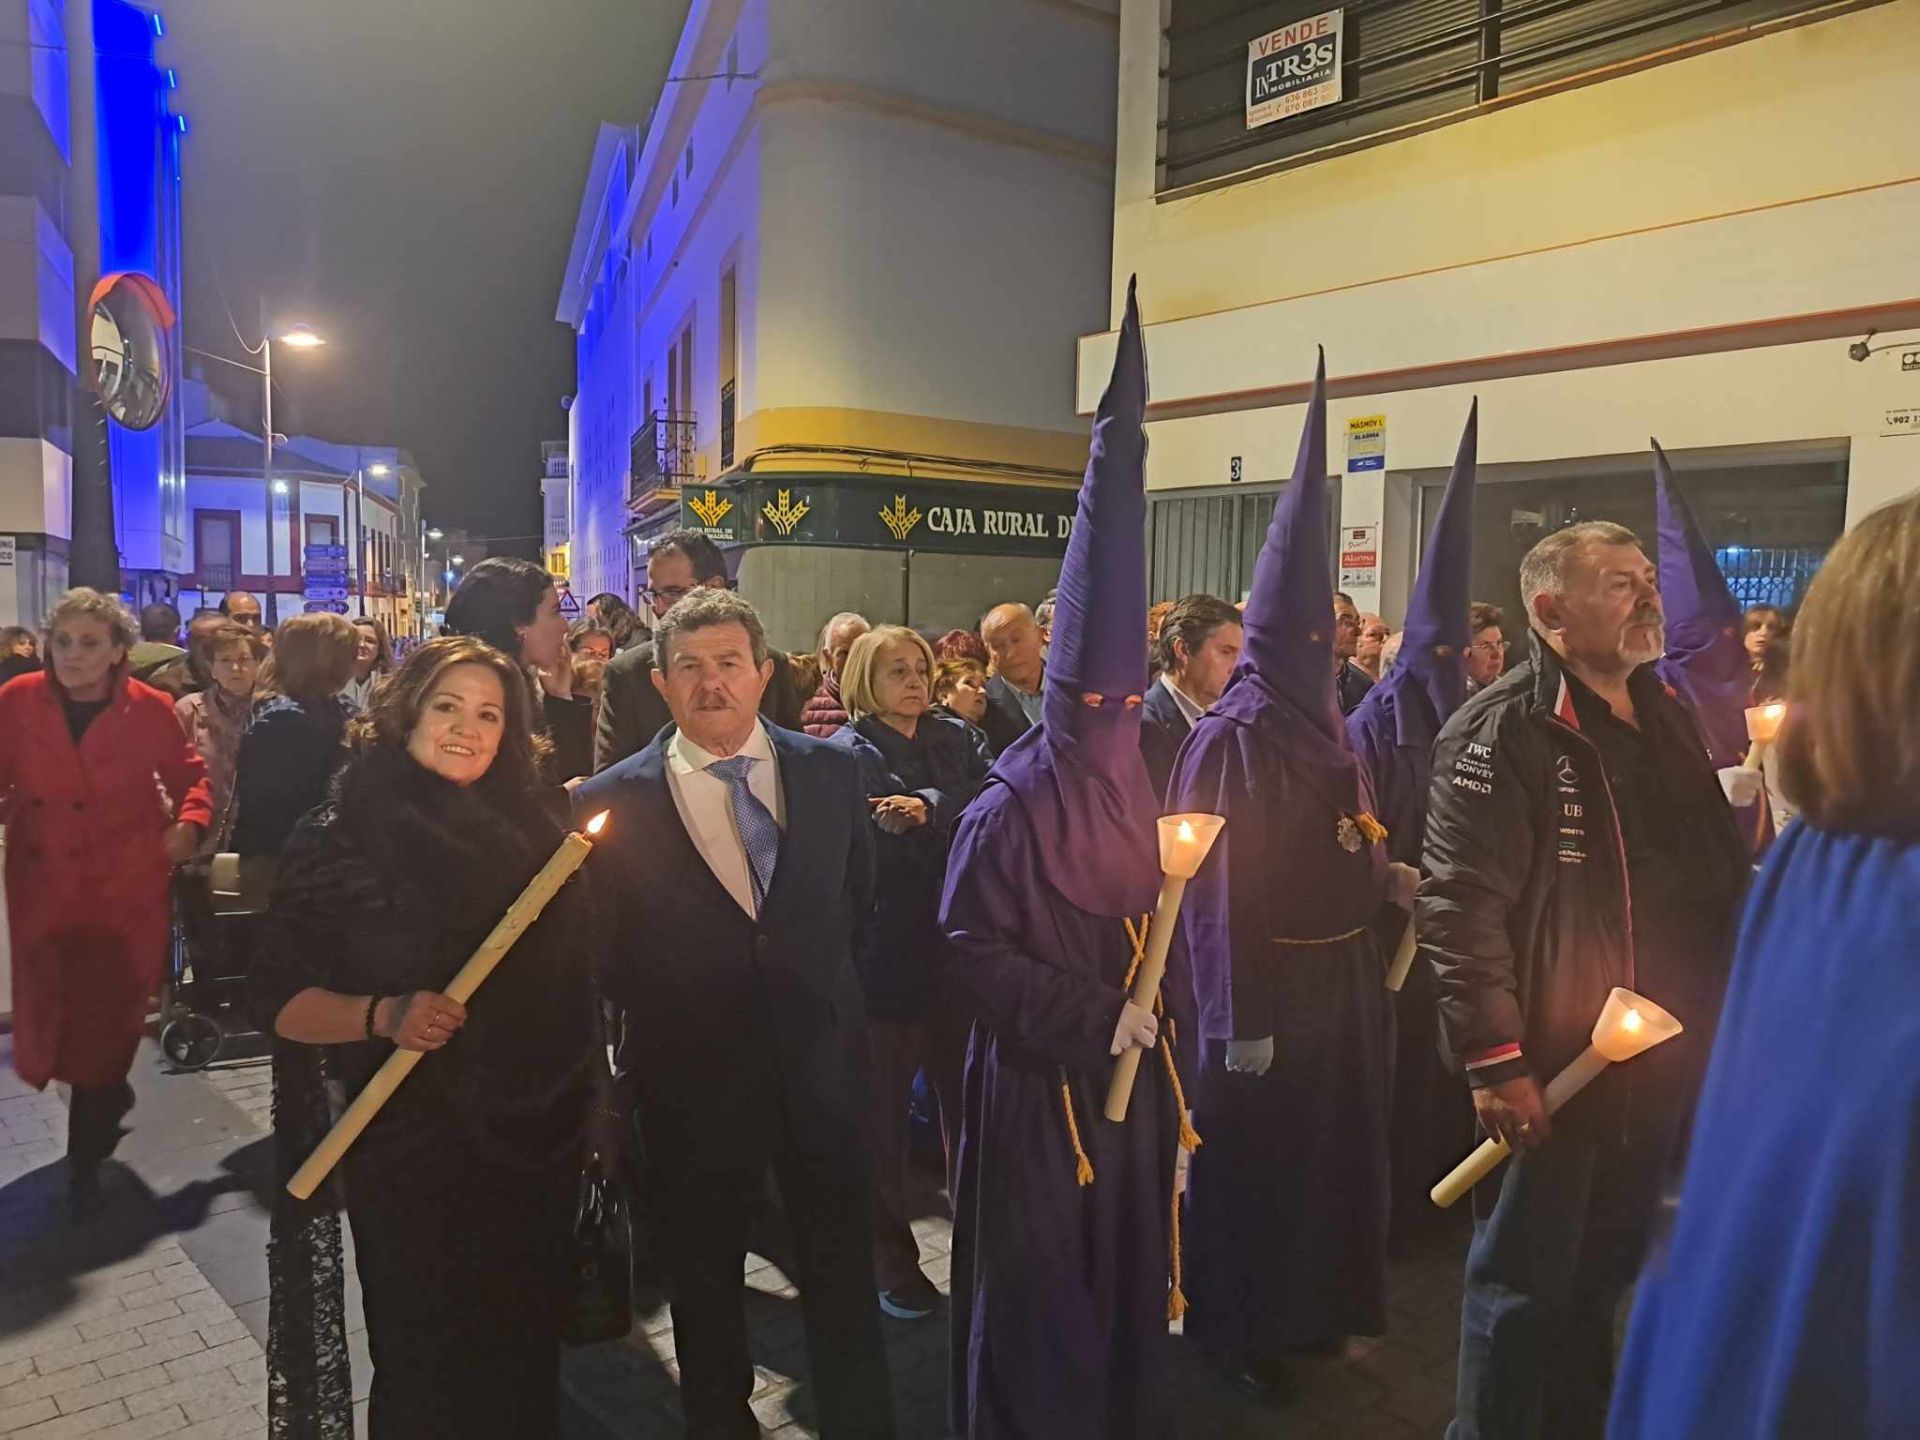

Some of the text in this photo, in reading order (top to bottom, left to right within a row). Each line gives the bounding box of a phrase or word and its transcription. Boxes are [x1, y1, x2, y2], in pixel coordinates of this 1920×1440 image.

[1258, 16, 1329, 56] VENDE
[1231, 458, 1241, 479] 3
[927, 506, 977, 536] CAJA
[983, 510, 1049, 538] RURAL
[1467, 742, 1492, 759] IWC
[1453, 775, 1482, 791] AMD
